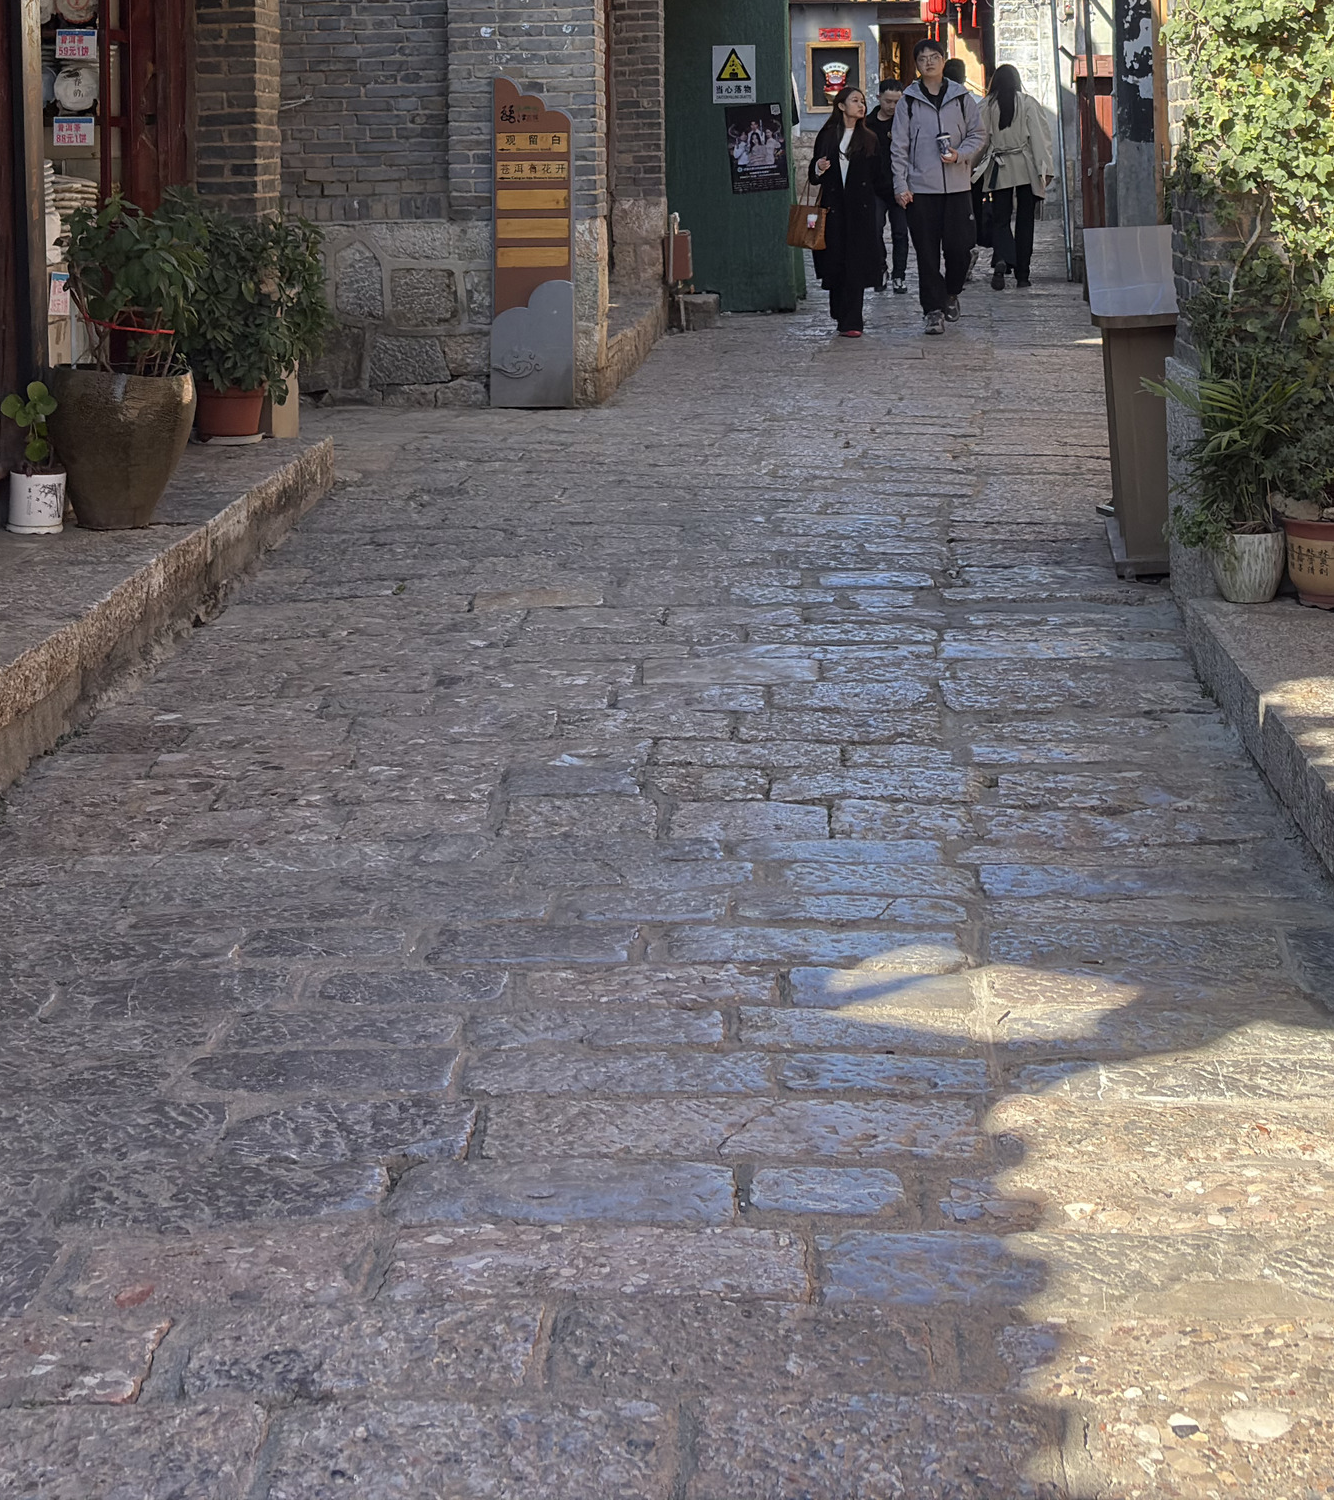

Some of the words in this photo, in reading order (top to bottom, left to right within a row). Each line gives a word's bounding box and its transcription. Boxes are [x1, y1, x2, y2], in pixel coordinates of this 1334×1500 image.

[716, 85, 752, 94] 当心落物
[505, 134, 561, 146] 观留白
